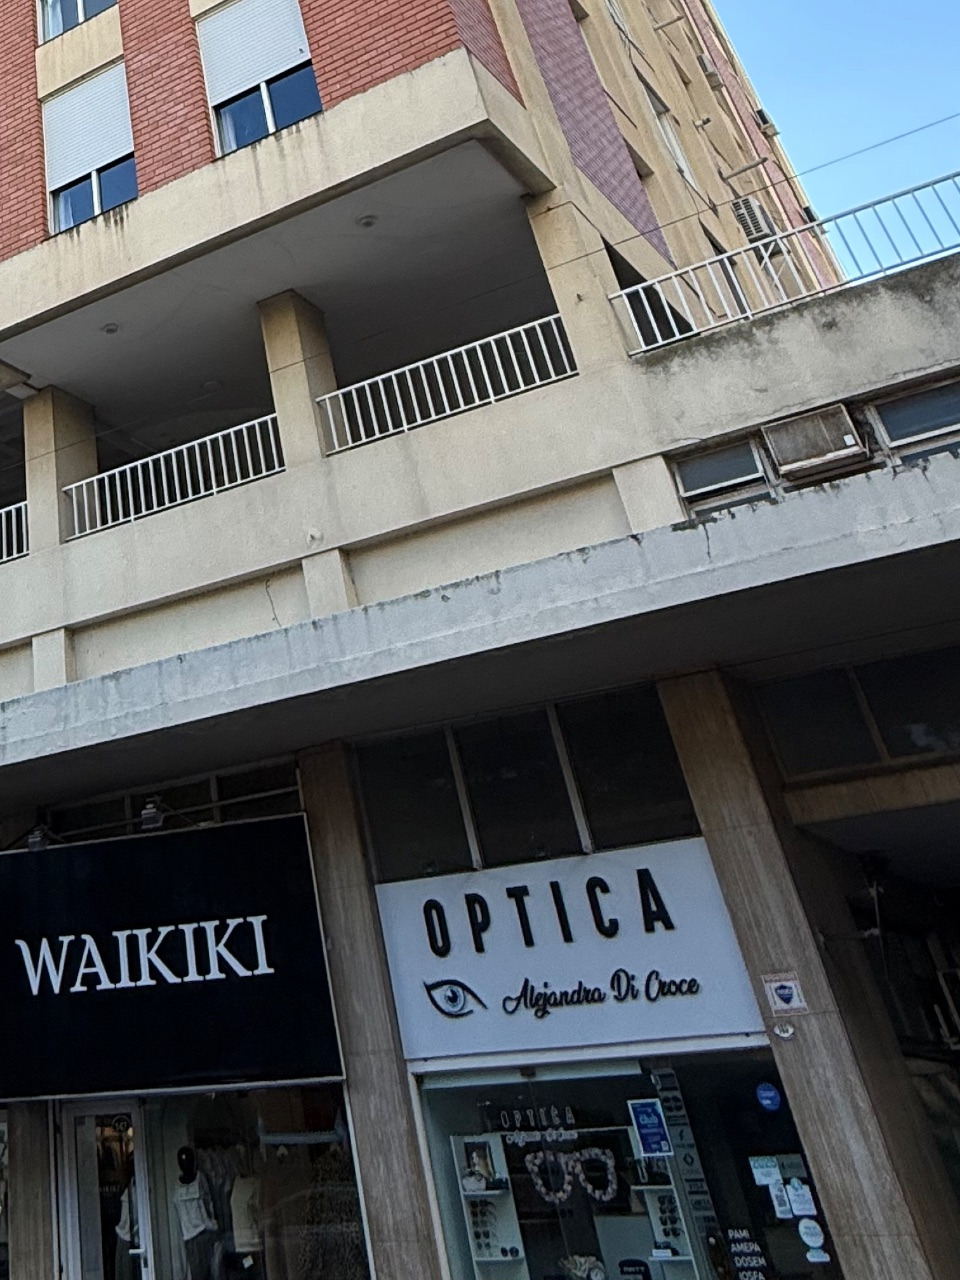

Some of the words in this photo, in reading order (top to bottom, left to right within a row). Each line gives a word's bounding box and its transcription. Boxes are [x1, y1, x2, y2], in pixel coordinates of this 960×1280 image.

[423, 868, 675, 958] OPTICA
[14, 915, 275, 996] WAIKIKI
[502, 978, 606, 1019] Alejandra
[609, 968, 640, 1002] Di
[644, 969, 700, 1002] Croce
